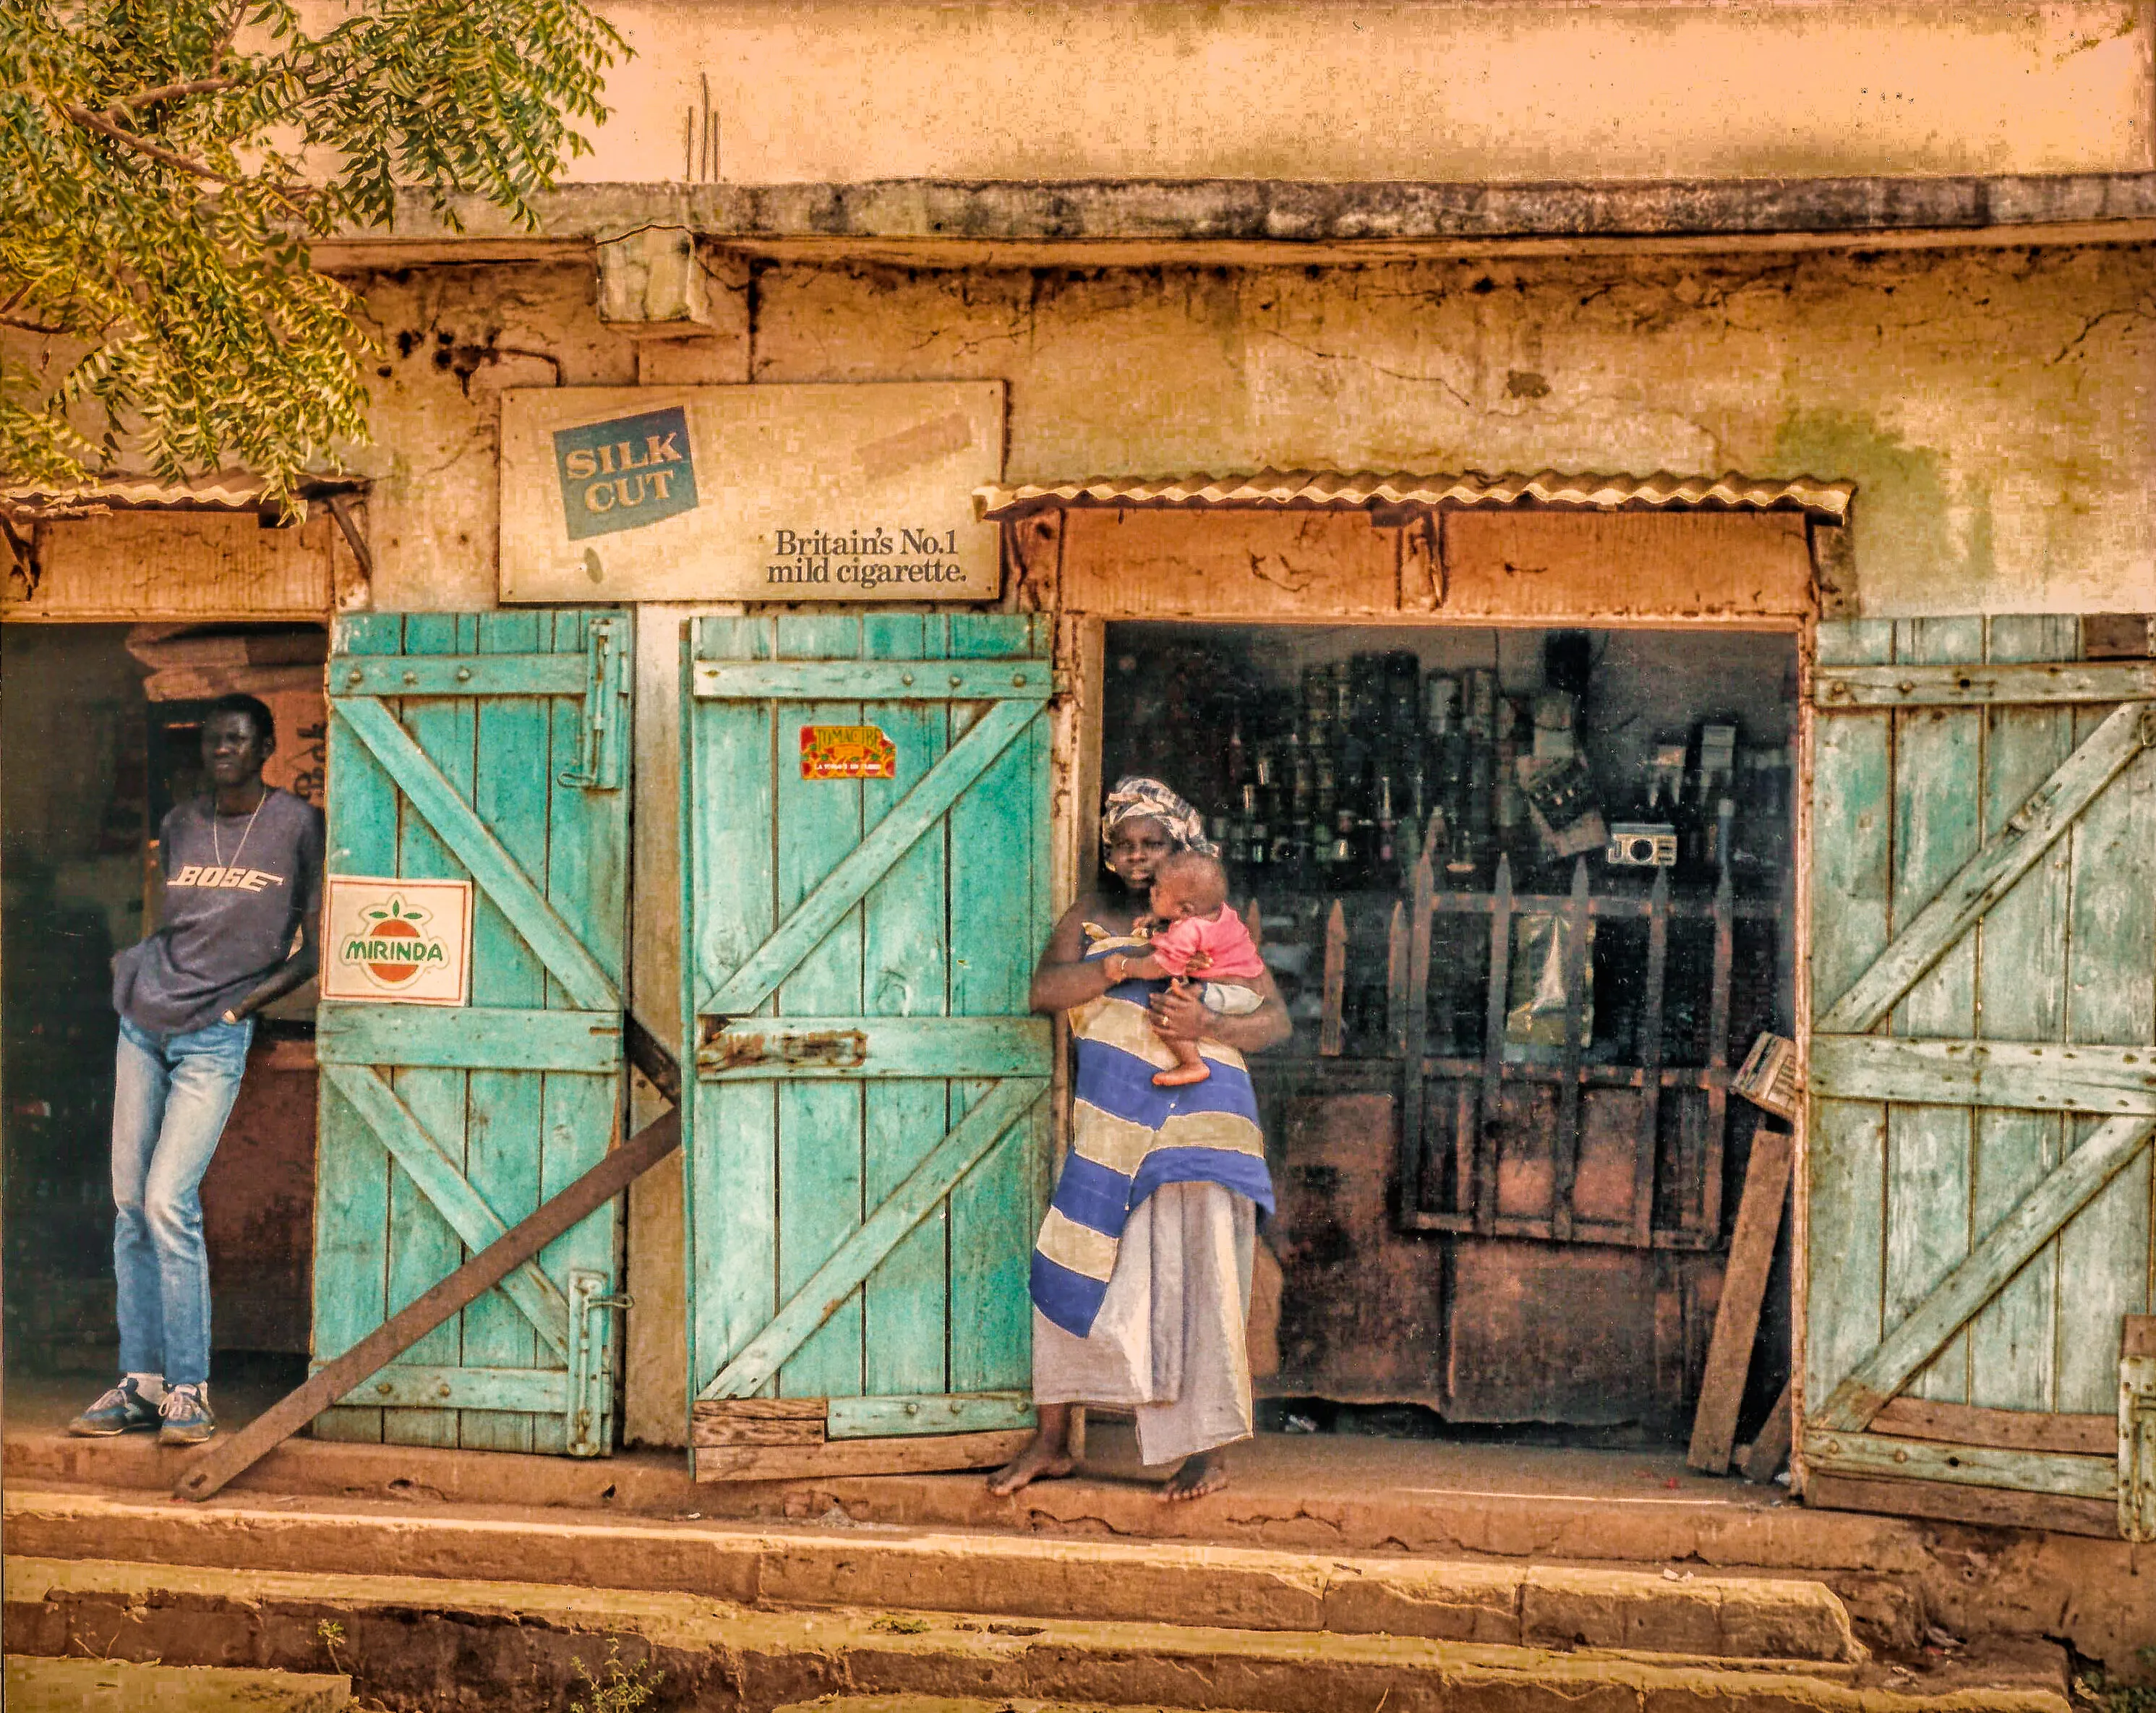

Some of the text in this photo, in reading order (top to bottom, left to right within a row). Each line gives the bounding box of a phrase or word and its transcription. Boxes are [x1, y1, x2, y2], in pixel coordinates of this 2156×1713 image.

[565, 432, 683, 480] SILK
[585, 470, 674, 514] CUT
[774, 526, 959, 555] Britain's No.1
[766, 556, 967, 589] mild cigarette.
[166, 866, 285, 894] BOSE
[345, 940, 443, 962] MIRINDA
